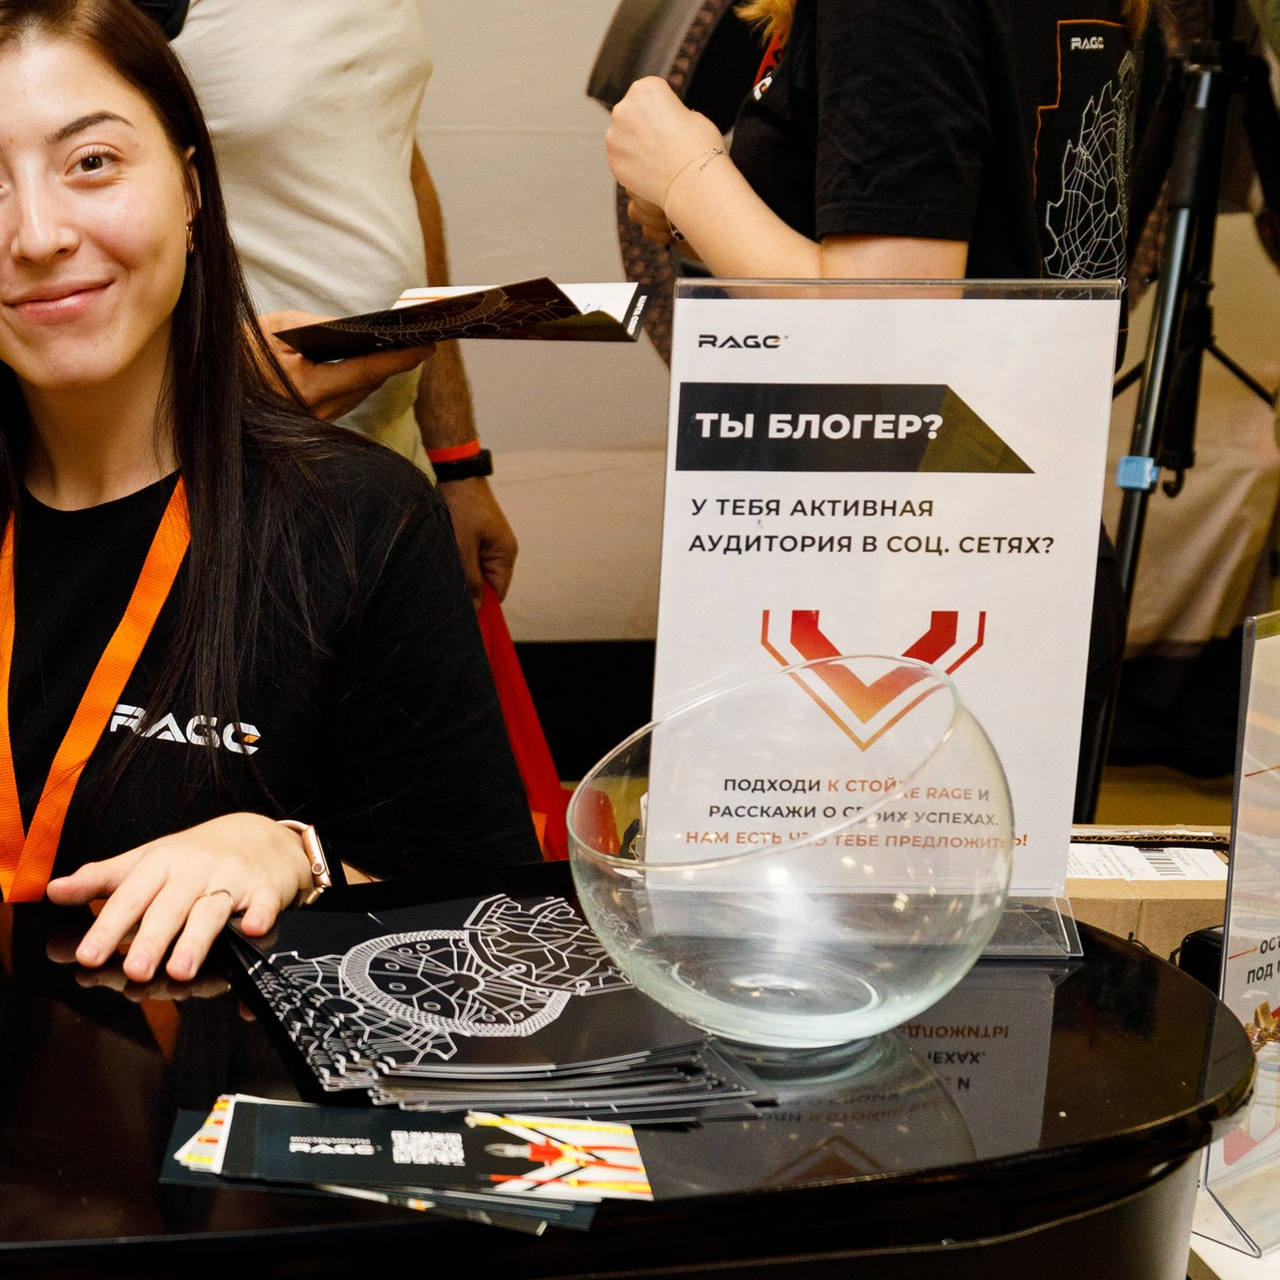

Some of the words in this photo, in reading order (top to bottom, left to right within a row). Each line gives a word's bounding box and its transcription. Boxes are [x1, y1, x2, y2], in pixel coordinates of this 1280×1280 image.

[1071, 36, 1105, 50] RAGE
[698, 334, 782, 349] RAGE
[695, 412, 754, 438] ТЫ
[768, 413, 943, 439] БЛОГЕР?
[691, 498, 708, 516] У
[716, 499, 781, 516] ТЕБЯ
[790, 499, 934, 517] АКТИВНАЯ
[688, 534, 852, 554] АУДИТОРИЯ
[862, 536, 878, 552] В
[886, 535, 949, 556] СОЦ.
[958, 536, 1055, 554] СЕТЯХ?
[110, 704, 262, 755] RAGE
[723, 778, 821, 793] ПОДХОДИ
[827, 778, 840, 792] К
[926, 786, 973, 800] RAGE
[978, 789, 989, 802] И
[709, 804, 817, 819] РАССКАЖИ
[823, 805, 838, 819] О
[914, 810, 999, 826] УСПЕХАХ.
[686, 831, 729, 845] НАМ
[736, 831, 783, 845] ЕСТЬ
[834, 834, 879, 848] ТЕБЕ
[1246, 963, 1273, 985] ПОД
